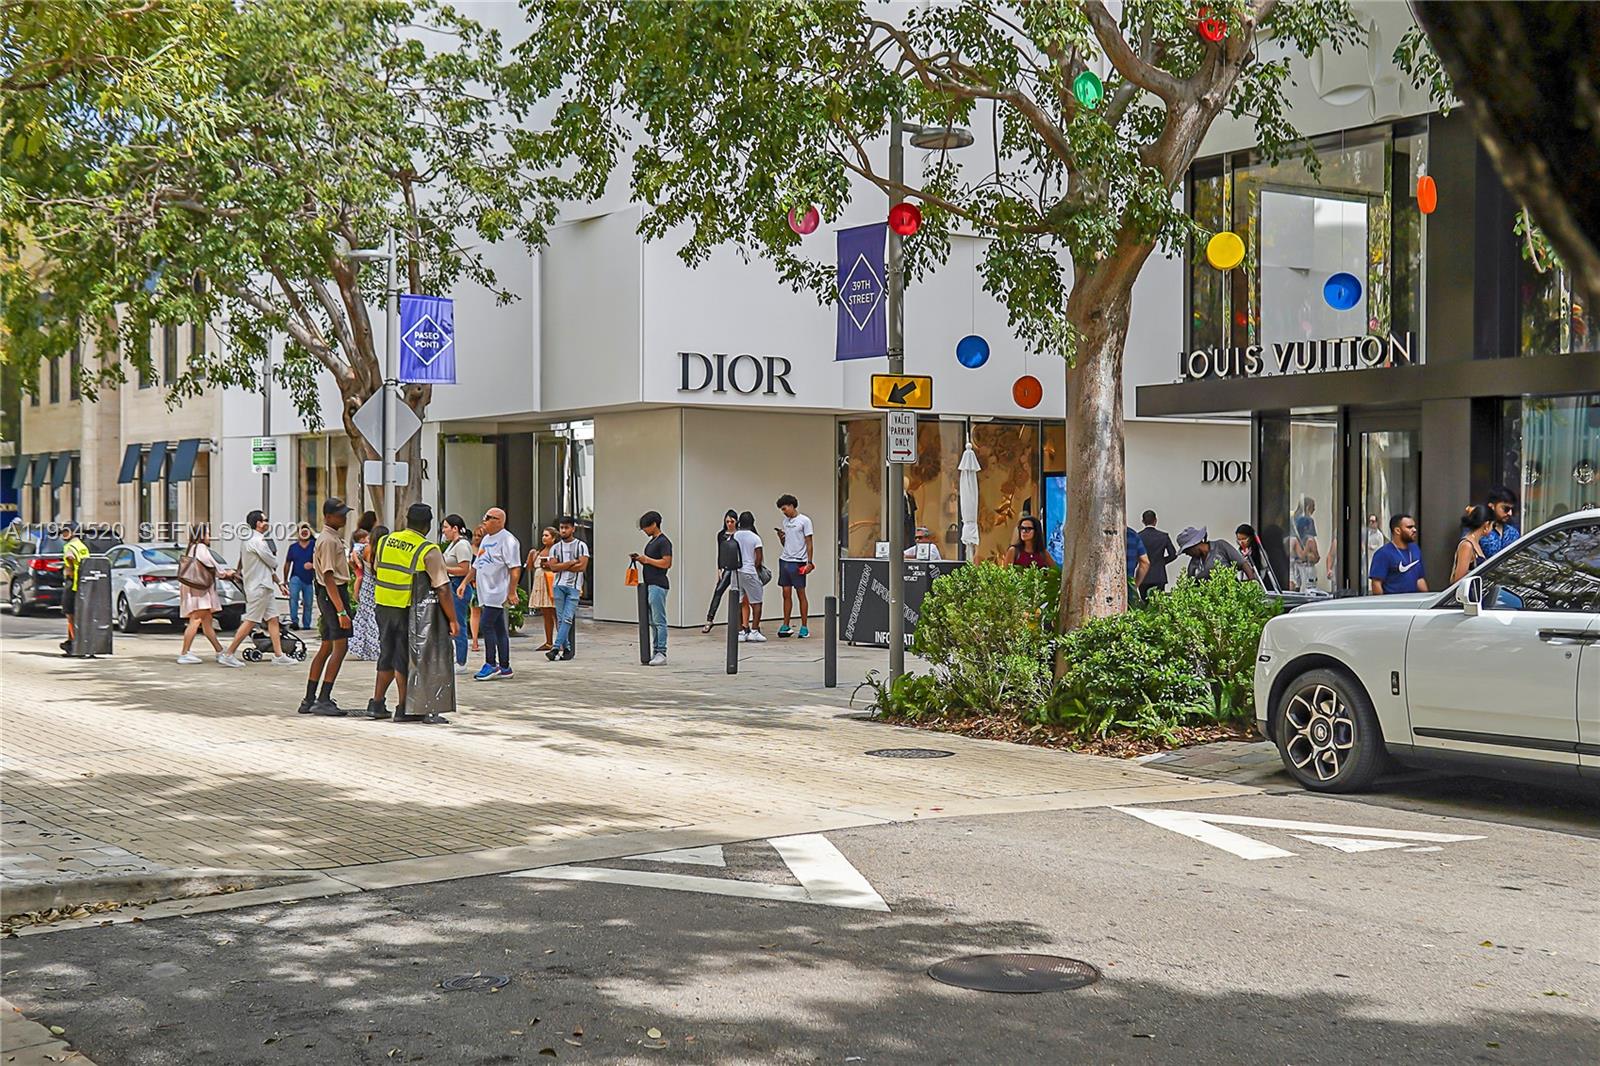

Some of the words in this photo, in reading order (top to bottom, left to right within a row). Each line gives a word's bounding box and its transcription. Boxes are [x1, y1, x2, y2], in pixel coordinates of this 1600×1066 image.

[852, 280, 871, 291] 39TH
[848, 292, 875, 305] STREET
[414, 331, 440, 340] PASEO
[415, 340, 439, 349] PONTI
[1177, 345, 1264, 380] LOUIS
[1271, 332, 1417, 373] VUITTON
[677, 352, 797, 396] DIOR
[894, 416, 910, 425] VALET
[890, 426, 914, 436] PARKING
[895, 438, 910, 447] ONLY
[1201, 460, 1252, 483] DIOR
[387, 537, 416, 553] SECURITY
[845, 563, 873, 641] INFORMATION
